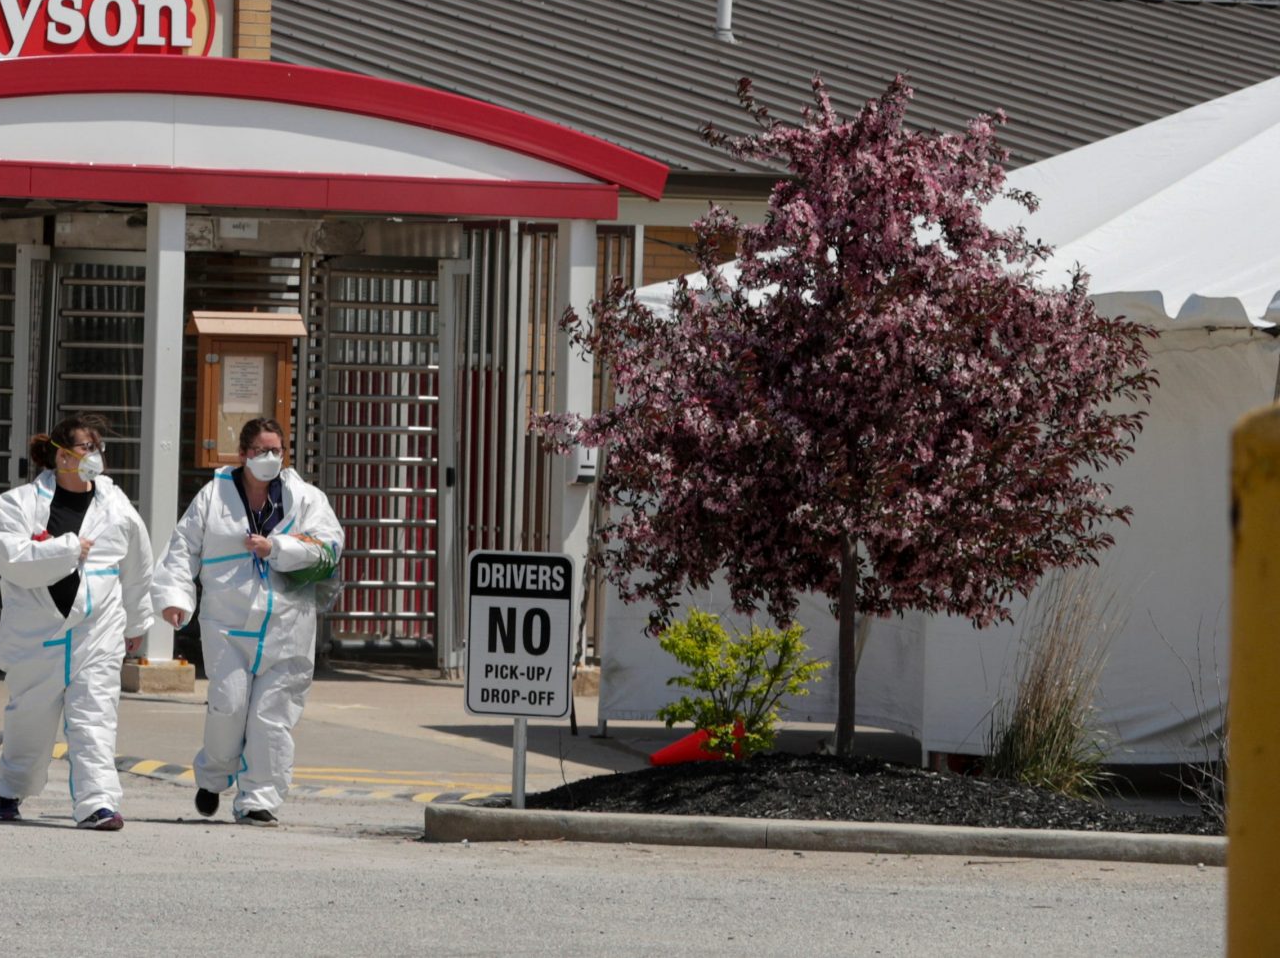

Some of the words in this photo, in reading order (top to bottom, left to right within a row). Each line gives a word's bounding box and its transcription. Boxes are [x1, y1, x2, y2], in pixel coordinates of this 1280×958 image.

[477, 562, 565, 592] DRIVERS
[487, 606, 551, 656] NO
[484, 664, 552, 682] PICK-UP/
[480, 688, 555, 706] DROP-OFF
